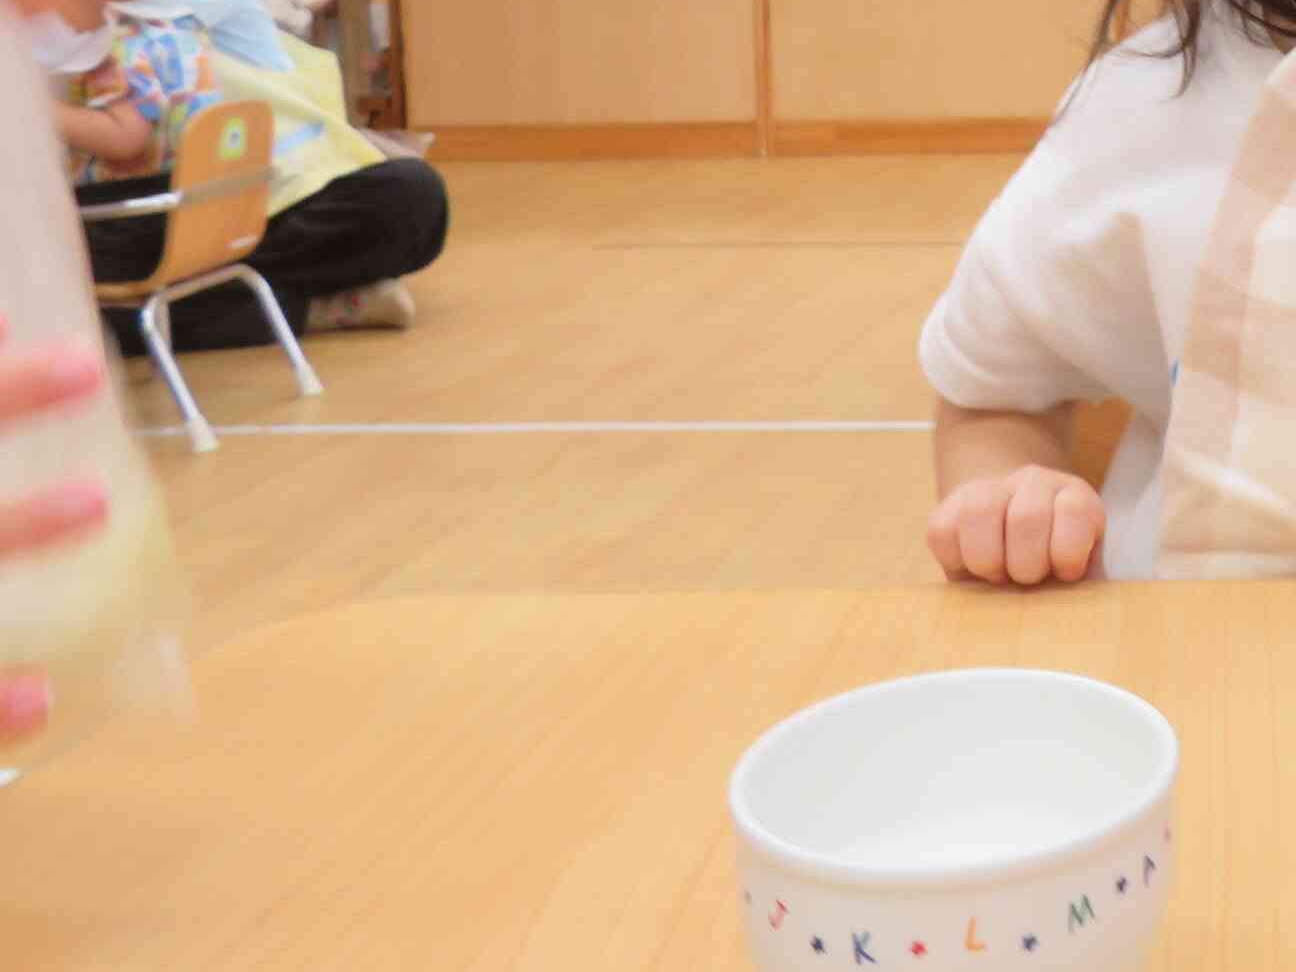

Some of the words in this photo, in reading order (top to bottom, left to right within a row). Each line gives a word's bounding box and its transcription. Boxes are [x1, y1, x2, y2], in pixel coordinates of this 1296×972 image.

[851, 930, 877, 966] K
[963, 916, 987, 953] L
[1067, 893, 1096, 933] M
